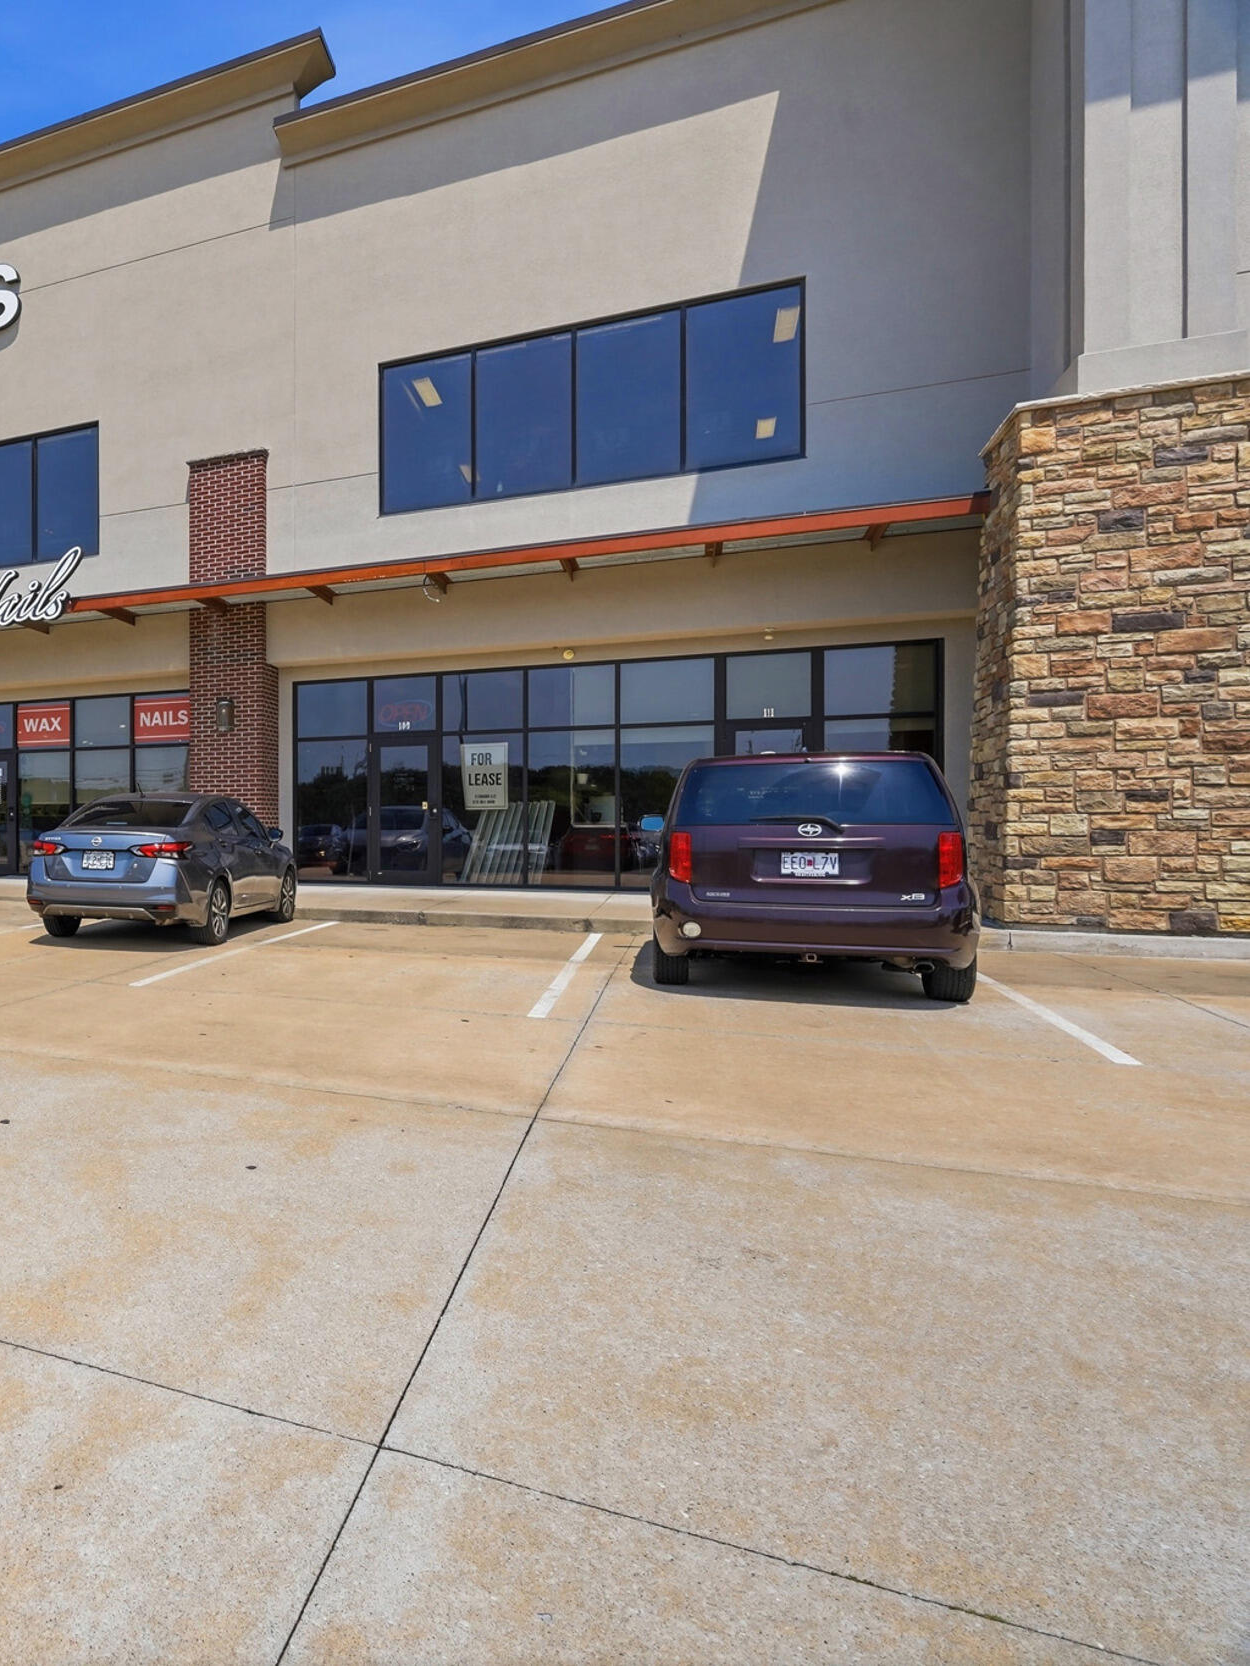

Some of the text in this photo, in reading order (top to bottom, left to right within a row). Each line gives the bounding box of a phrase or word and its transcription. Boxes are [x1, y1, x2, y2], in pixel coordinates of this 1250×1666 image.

[23, 716, 62, 733] WAX
[139, 709, 189, 728] NAILS
[470, 752, 493, 766] FOR
[468, 772, 503, 786] LEASE
[812, 855, 839, 870] L7V
